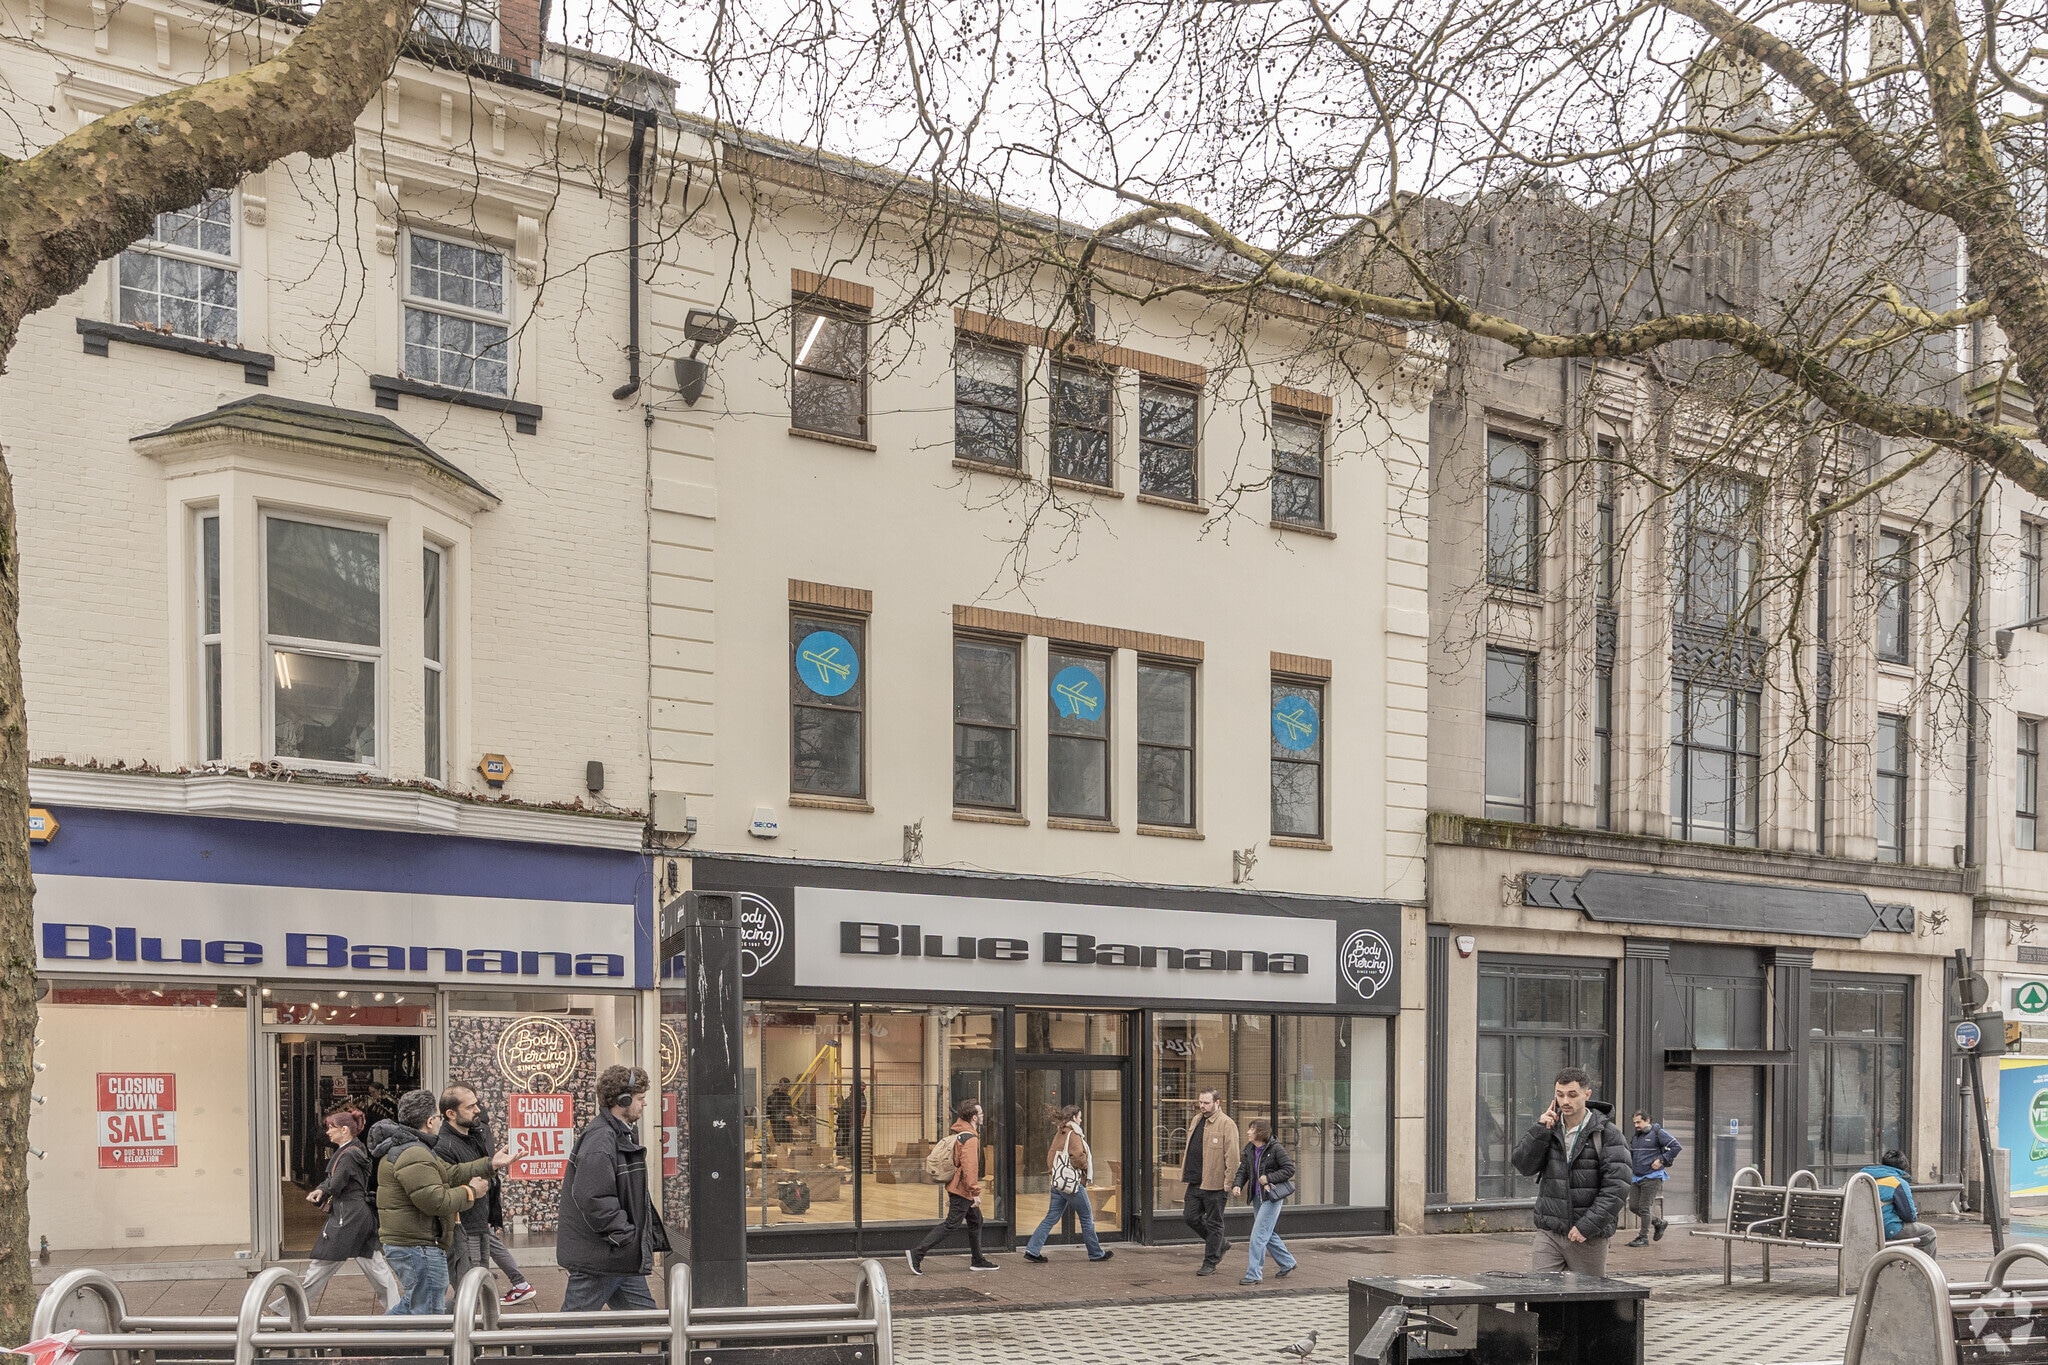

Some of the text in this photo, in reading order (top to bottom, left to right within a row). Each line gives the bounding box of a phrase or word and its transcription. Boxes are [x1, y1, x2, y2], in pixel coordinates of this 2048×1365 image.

[488, 762, 503, 771] ADT
[754, 821, 777, 829] SECOM
[741, 907, 766, 929] ody
[741, 927, 773, 946] rcing
[42, 923, 263, 965] Blue
[286, 933, 625, 977] Banana
[840, 921, 1309, 974] Blue Banana
[1353, 940, 1382, 960] Body
[1348, 954, 1386, 974] Piercing
[516, 1029, 558, 1051] Body
[508, 1047, 567, 1066] Piercing
[108, 1077, 165, 1094] CLOSING
[116, 1094, 158, 1110] DOWN
[518, 1097, 564, 1113] CLOSING
[107, 1113, 166, 1143] SALE
[524, 1113, 558, 1127] DOWN
[516, 1130, 565, 1157] SALE
[124, 1155, 159, 1163] RELOCATION
